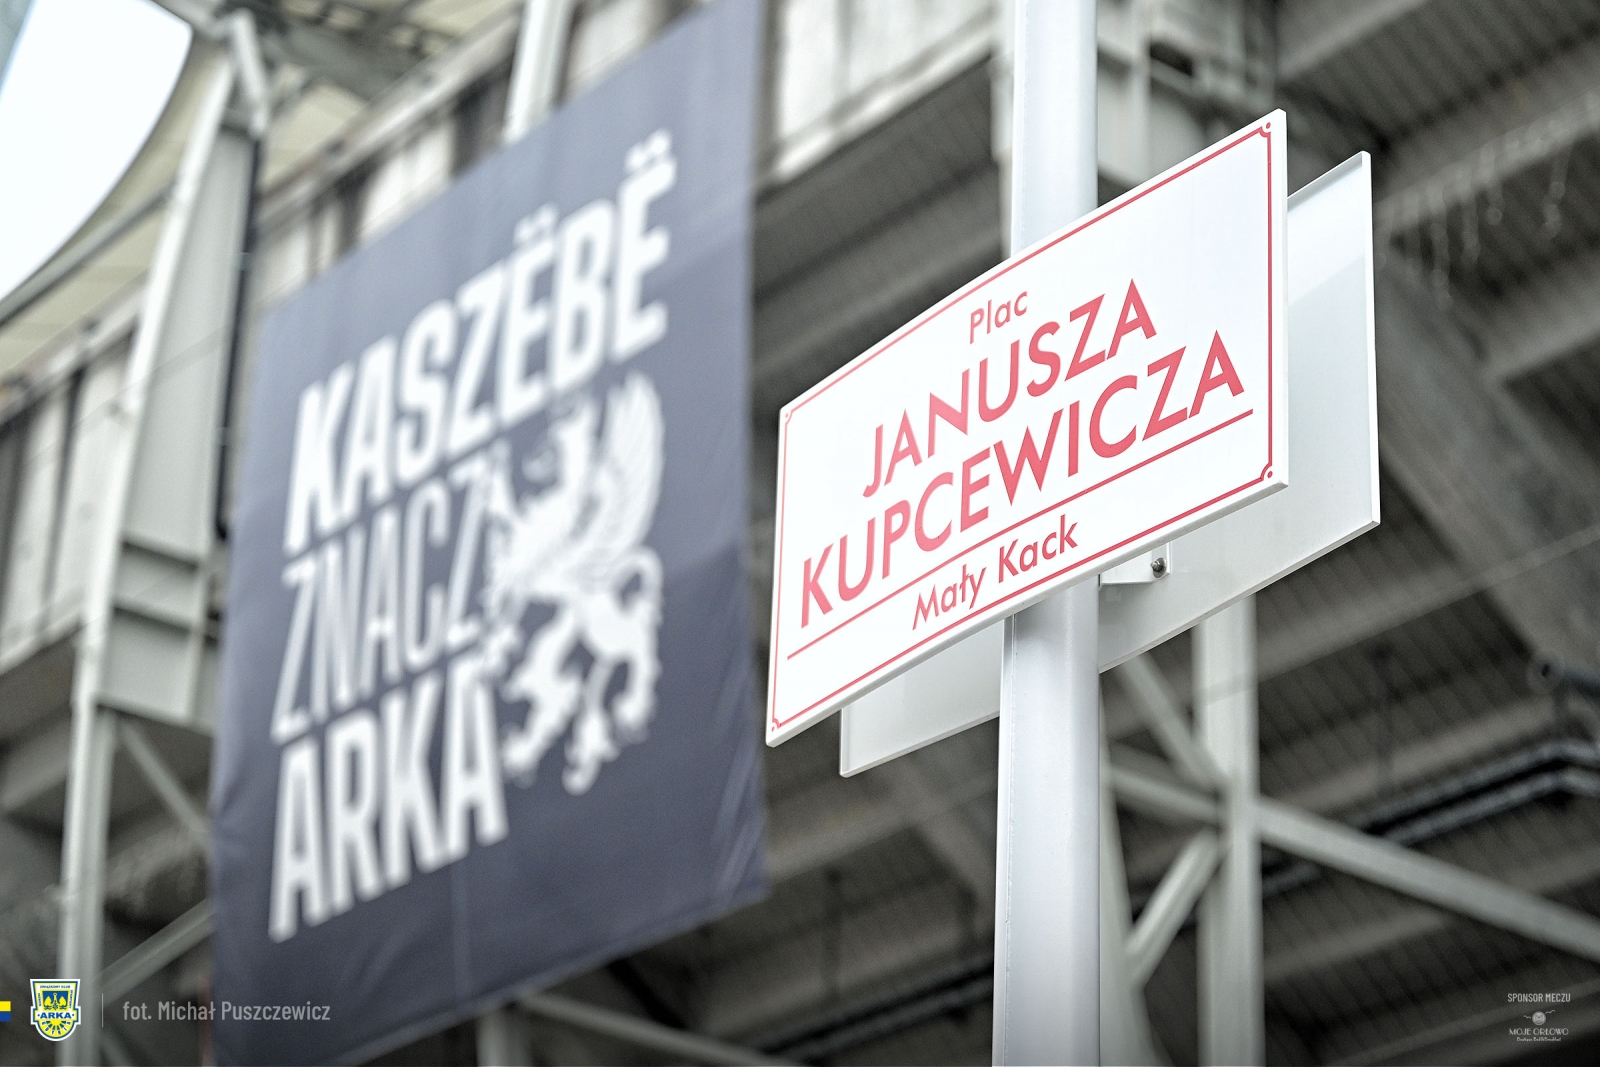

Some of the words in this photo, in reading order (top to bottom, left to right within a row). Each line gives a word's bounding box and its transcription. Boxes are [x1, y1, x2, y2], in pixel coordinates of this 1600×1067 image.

[284, 130, 676, 553] KASZËBË
[863, 279, 1157, 497] JANUSZA
[969, 292, 1028, 343] Plac
[801, 331, 1245, 628] KUPCEWICZA
[912, 565, 987, 630] Mały
[998, 515, 1078, 583] Kack
[268, 650, 508, 941] ARKA
